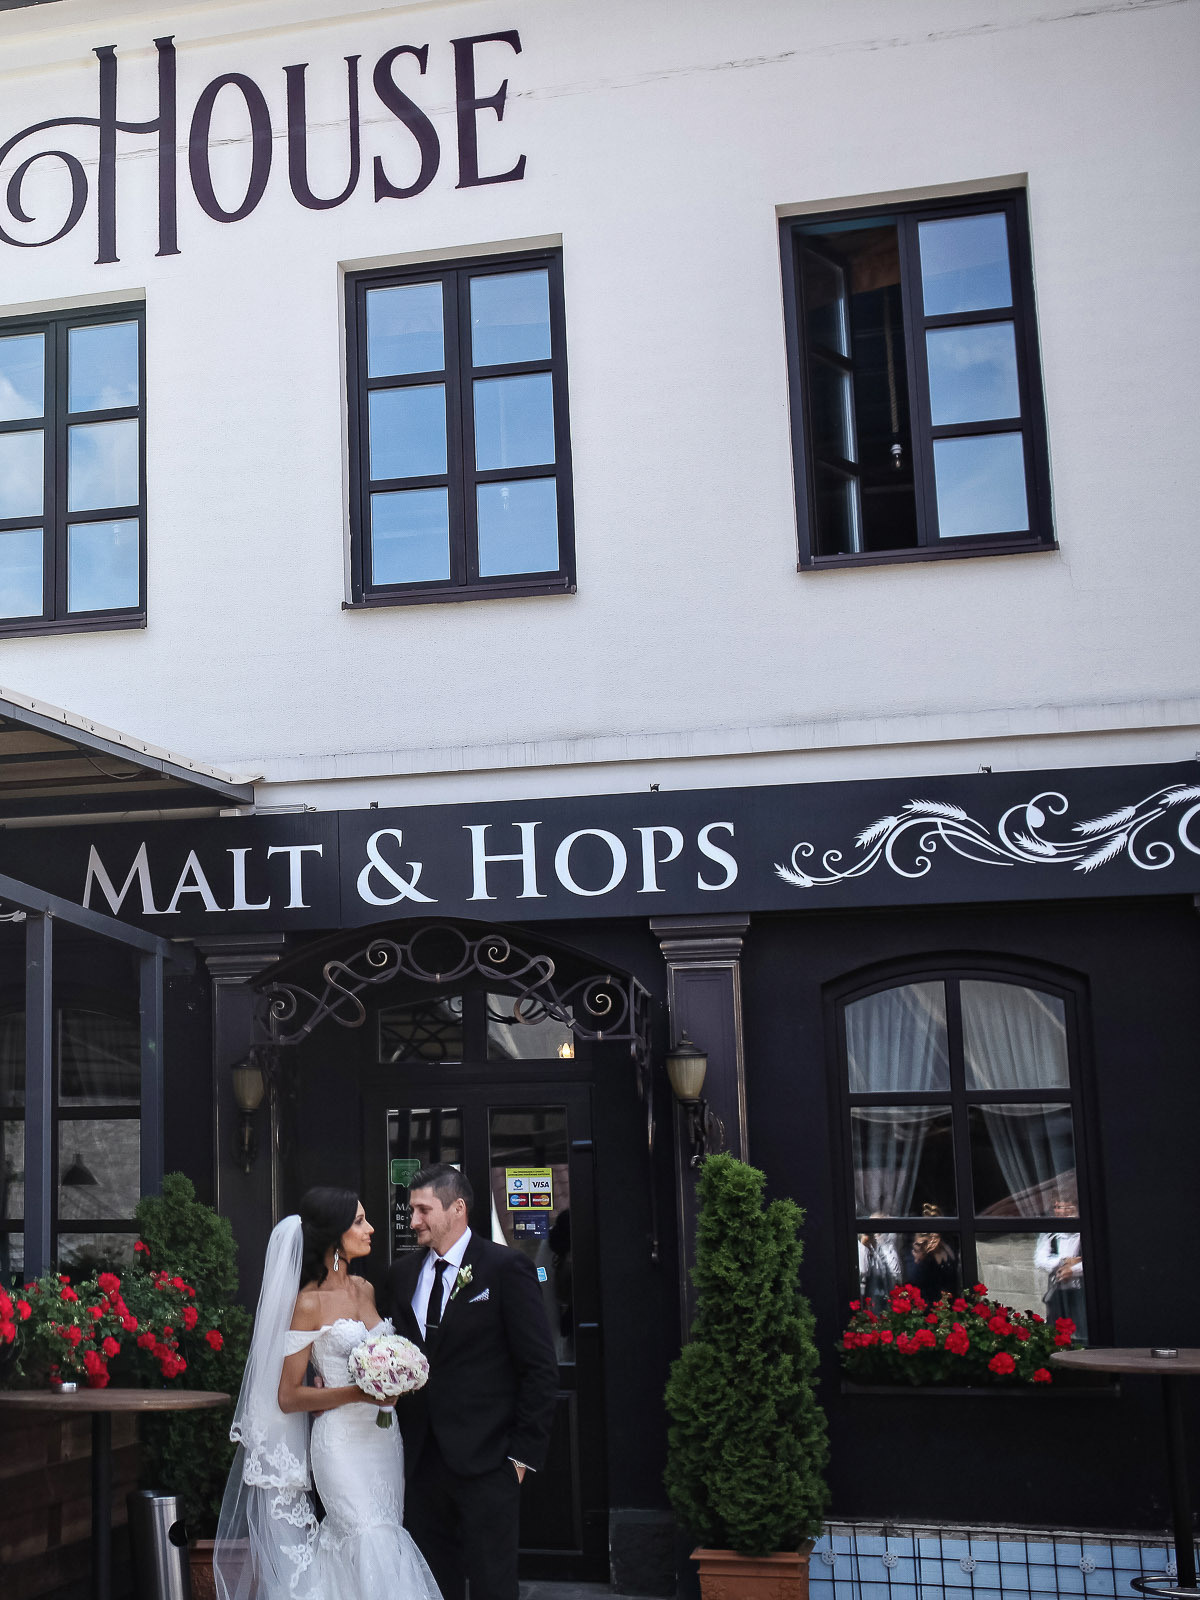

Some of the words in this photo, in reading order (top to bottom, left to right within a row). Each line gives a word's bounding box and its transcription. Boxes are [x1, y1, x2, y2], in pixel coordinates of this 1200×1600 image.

[82, 841, 323, 916] MALT
[356, 828, 439, 906] &
[462, 821, 740, 901] HOPS
